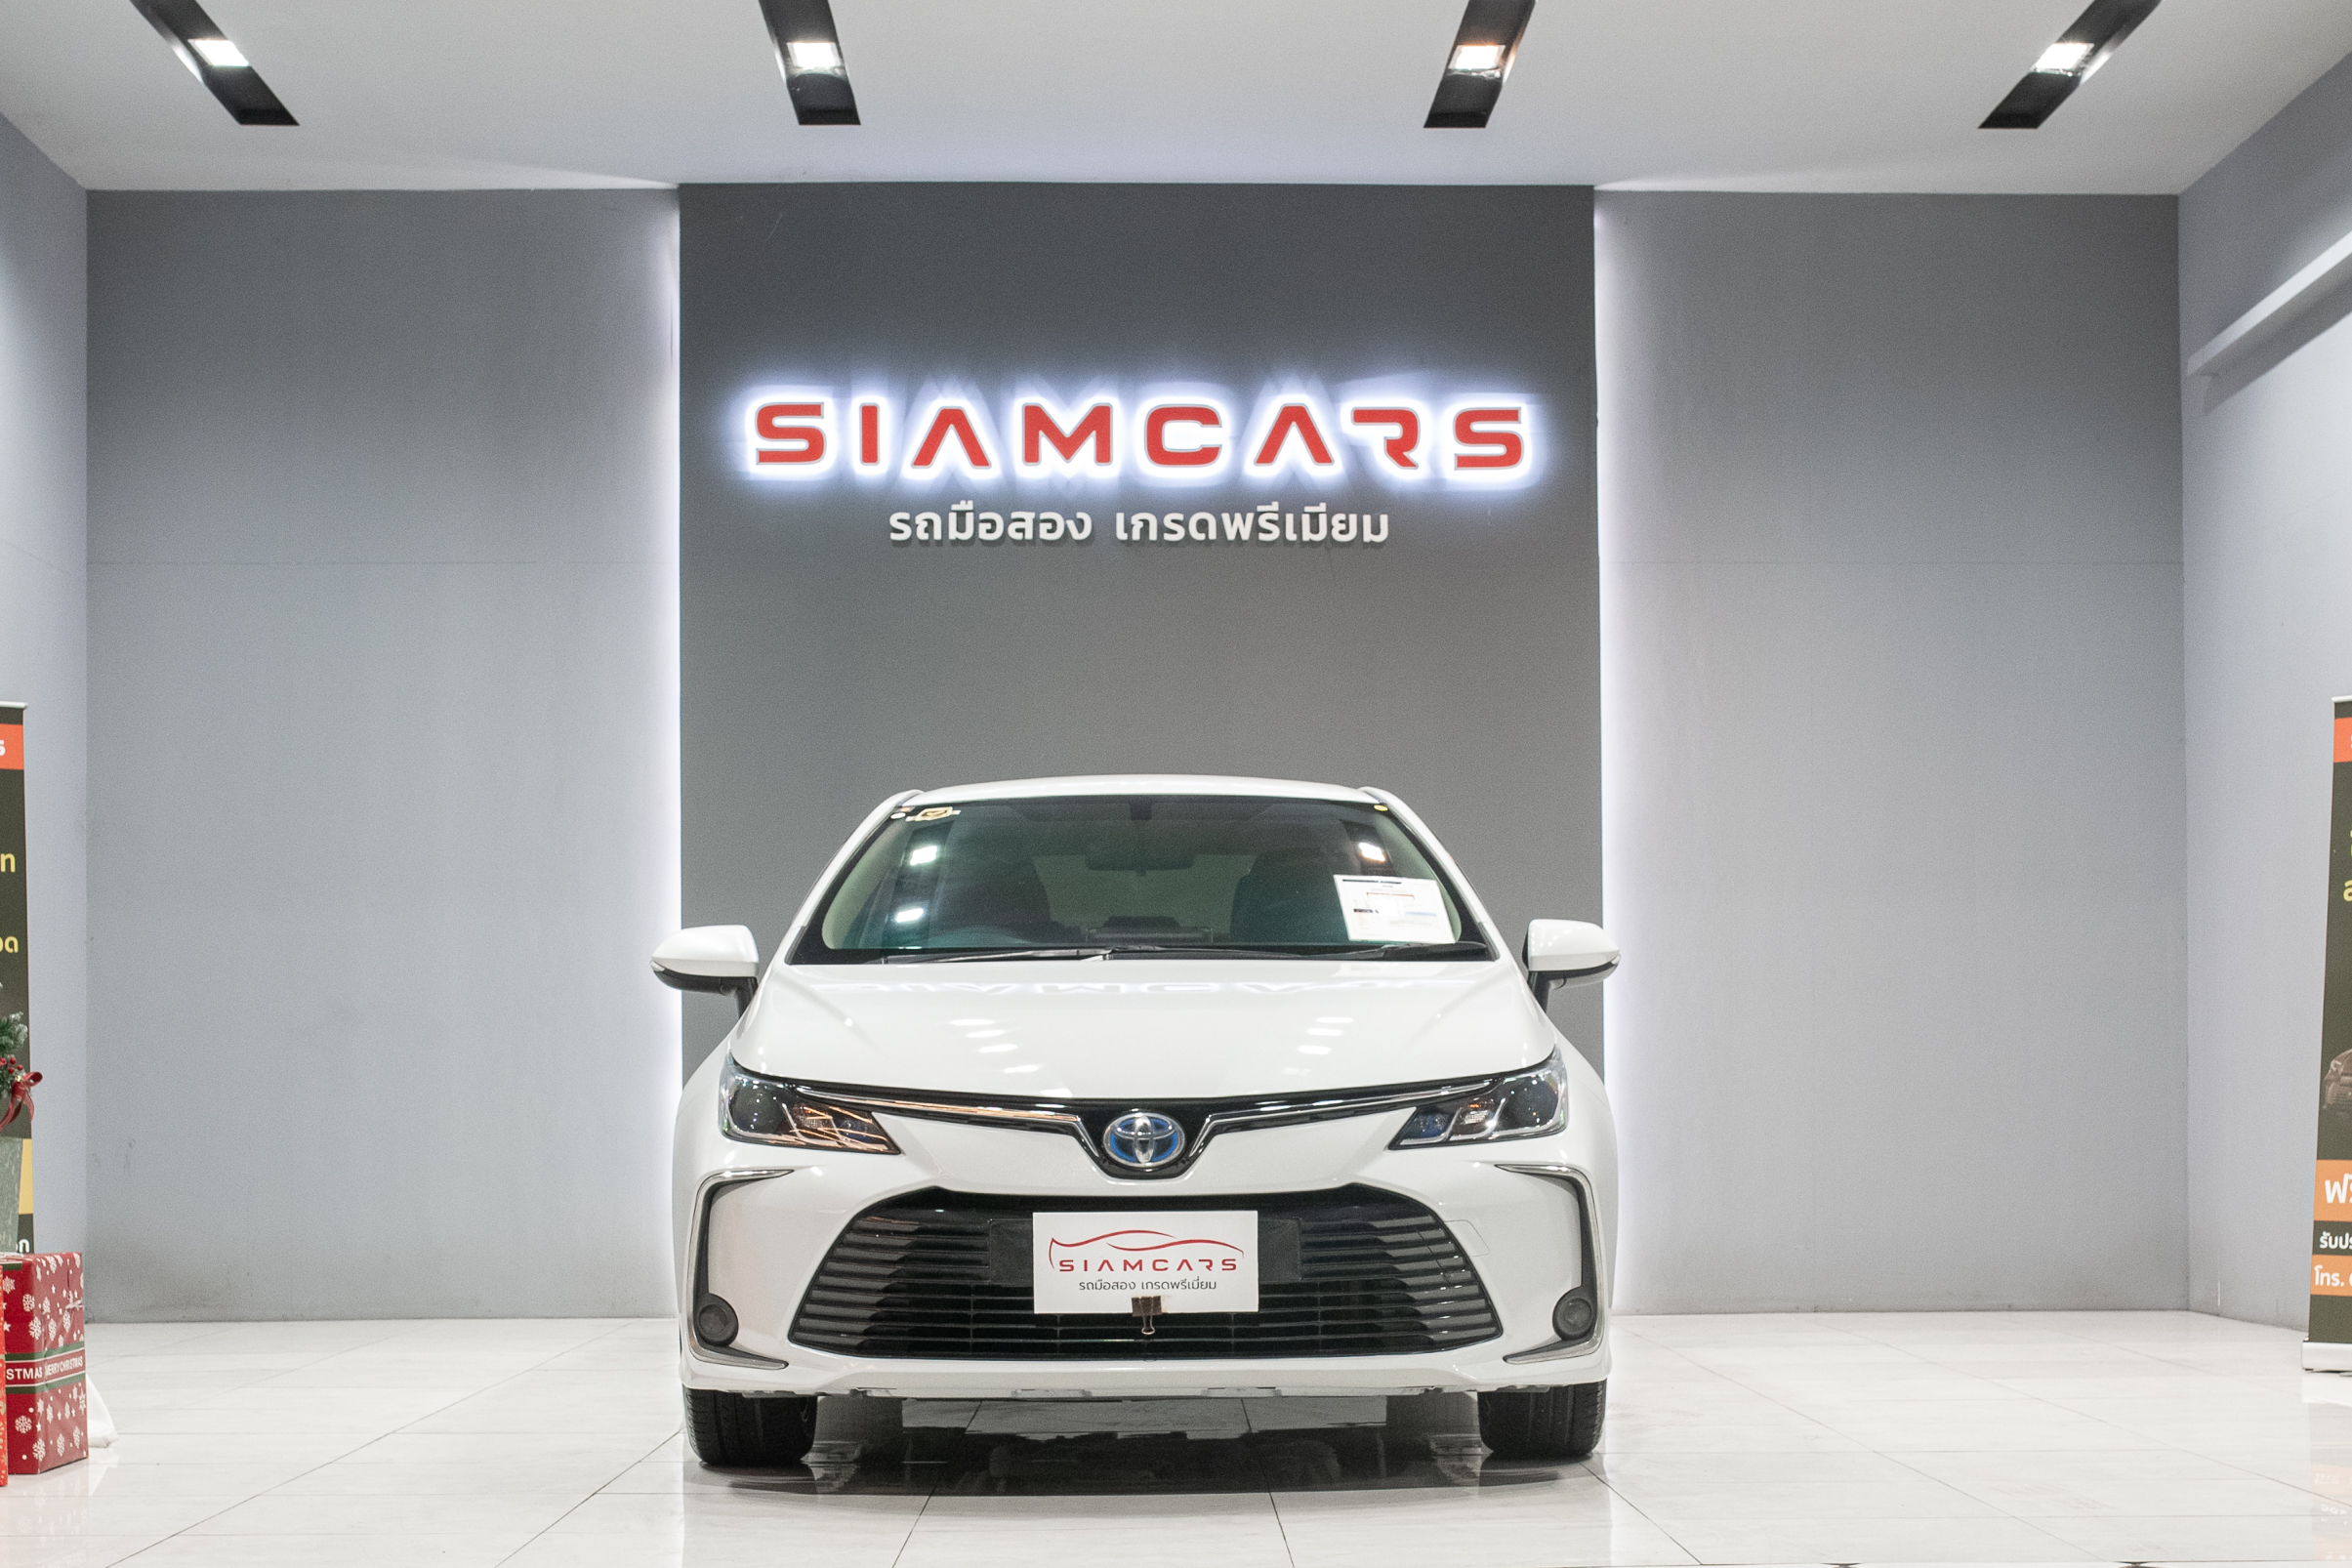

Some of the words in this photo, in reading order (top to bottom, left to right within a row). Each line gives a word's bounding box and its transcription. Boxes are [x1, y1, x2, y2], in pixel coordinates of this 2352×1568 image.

[755, 402, 1525, 471] SIAMCARS
[888, 500, 1093, 541] รถมือสอง
[1115, 501, 1389, 543] เกรดพรีเมียม
[1058, 1259, 1237, 1272] SIAMCARS
[1079, 1278, 1136, 1291] รถมือสอง
[1141, 1275, 1217, 1291] เกรดพรีเมี่ยม
